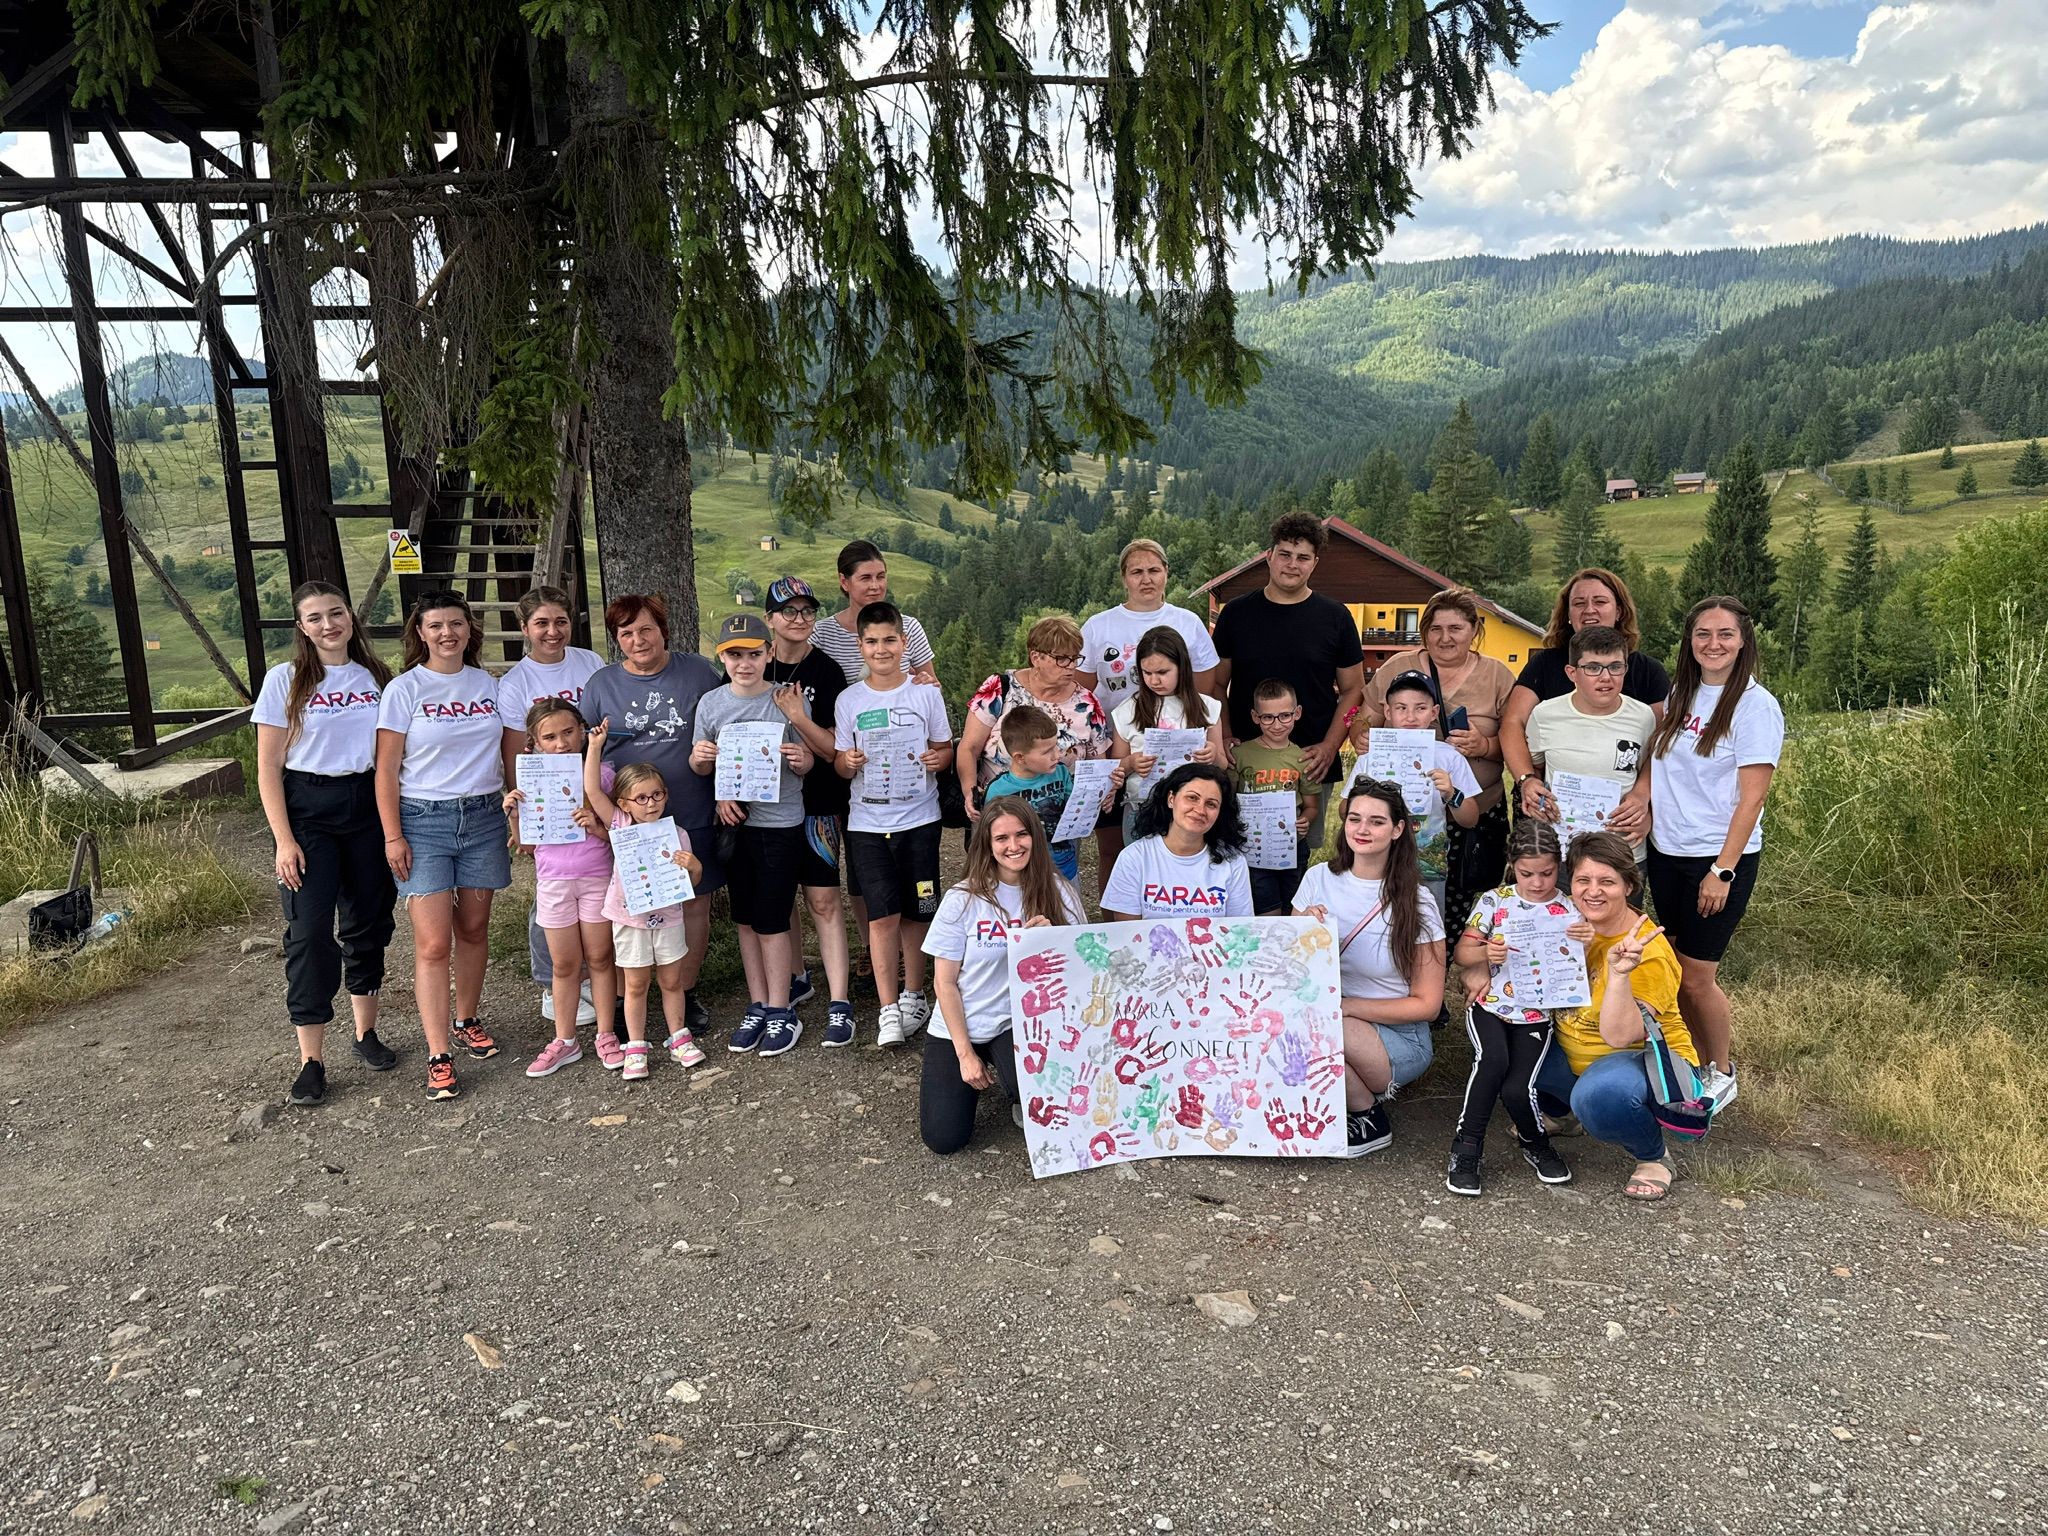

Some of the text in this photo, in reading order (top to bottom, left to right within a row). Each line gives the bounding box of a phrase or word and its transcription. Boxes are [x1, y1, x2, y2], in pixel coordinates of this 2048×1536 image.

[309, 691, 365, 708] ARA
[422, 701, 486, 717] FARA
[1144, 884, 1210, 905] FARA
[1147, 1026, 1252, 1060] CONNECT
